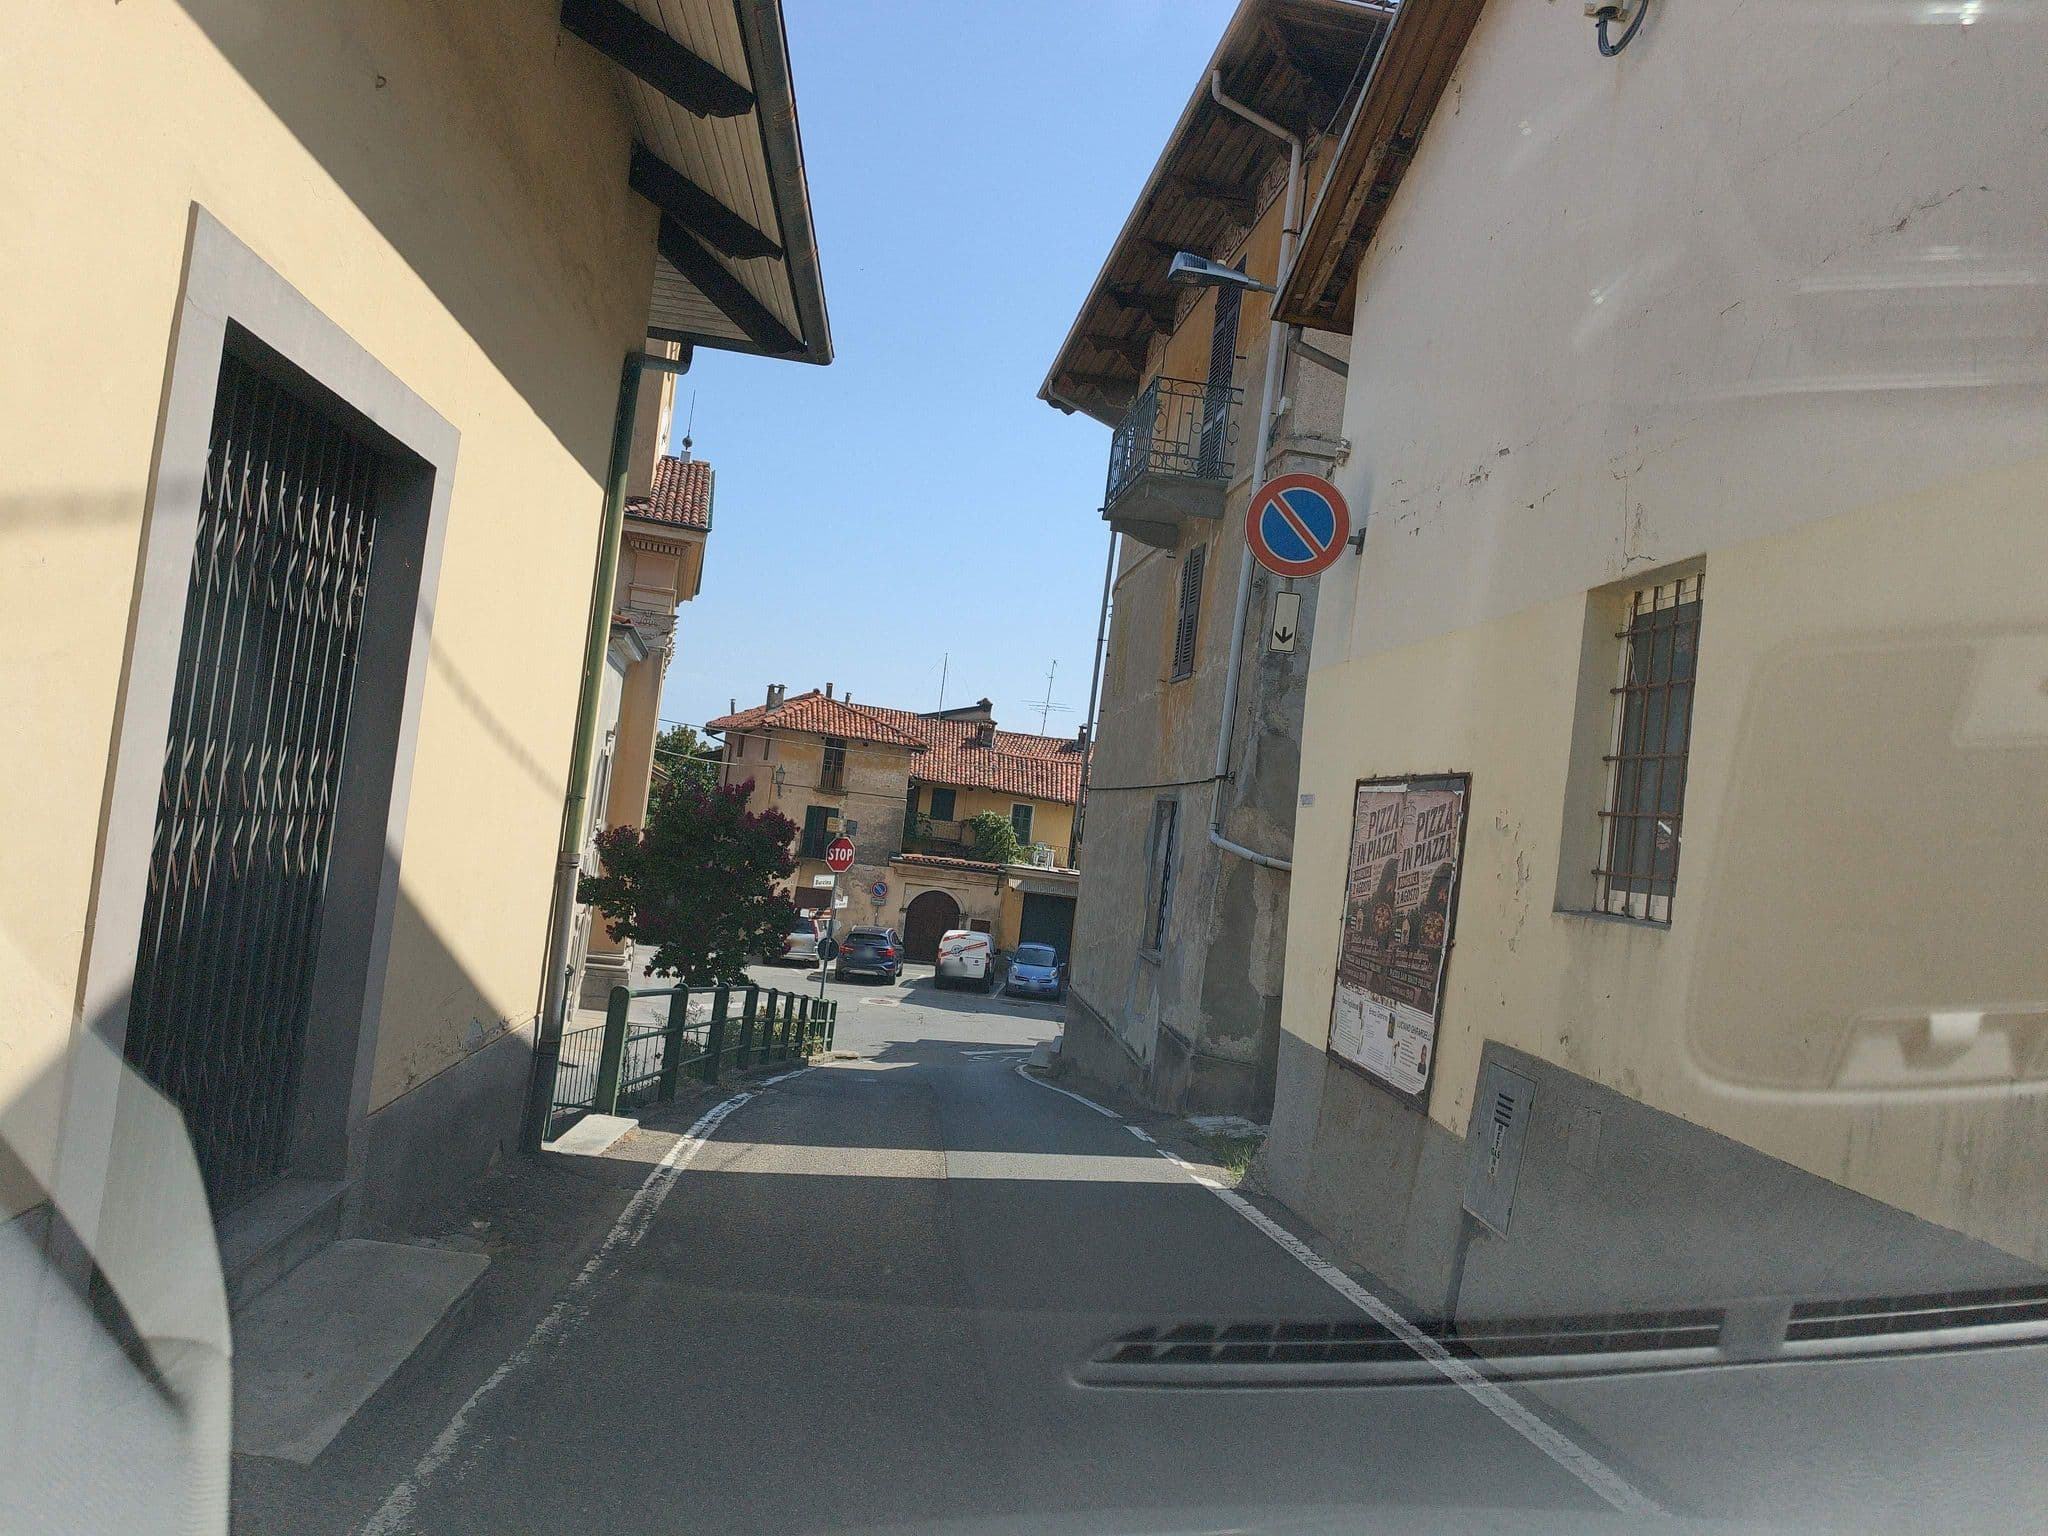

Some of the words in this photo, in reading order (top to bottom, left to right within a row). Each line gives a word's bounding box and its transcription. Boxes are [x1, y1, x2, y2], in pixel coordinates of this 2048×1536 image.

[1368, 802, 1400, 839] PIZZA
[1415, 801, 1453, 842] PIZZA
[828, 848, 853, 861] STOP
[1357, 842, 1367, 866] IN
[1367, 832, 1398, 863] PIAZZA
[1402, 848, 1413, 872] IN
[1413, 833, 1452, 868] PIAZZA
[1400, 887, 1419, 904] AGOSTO
